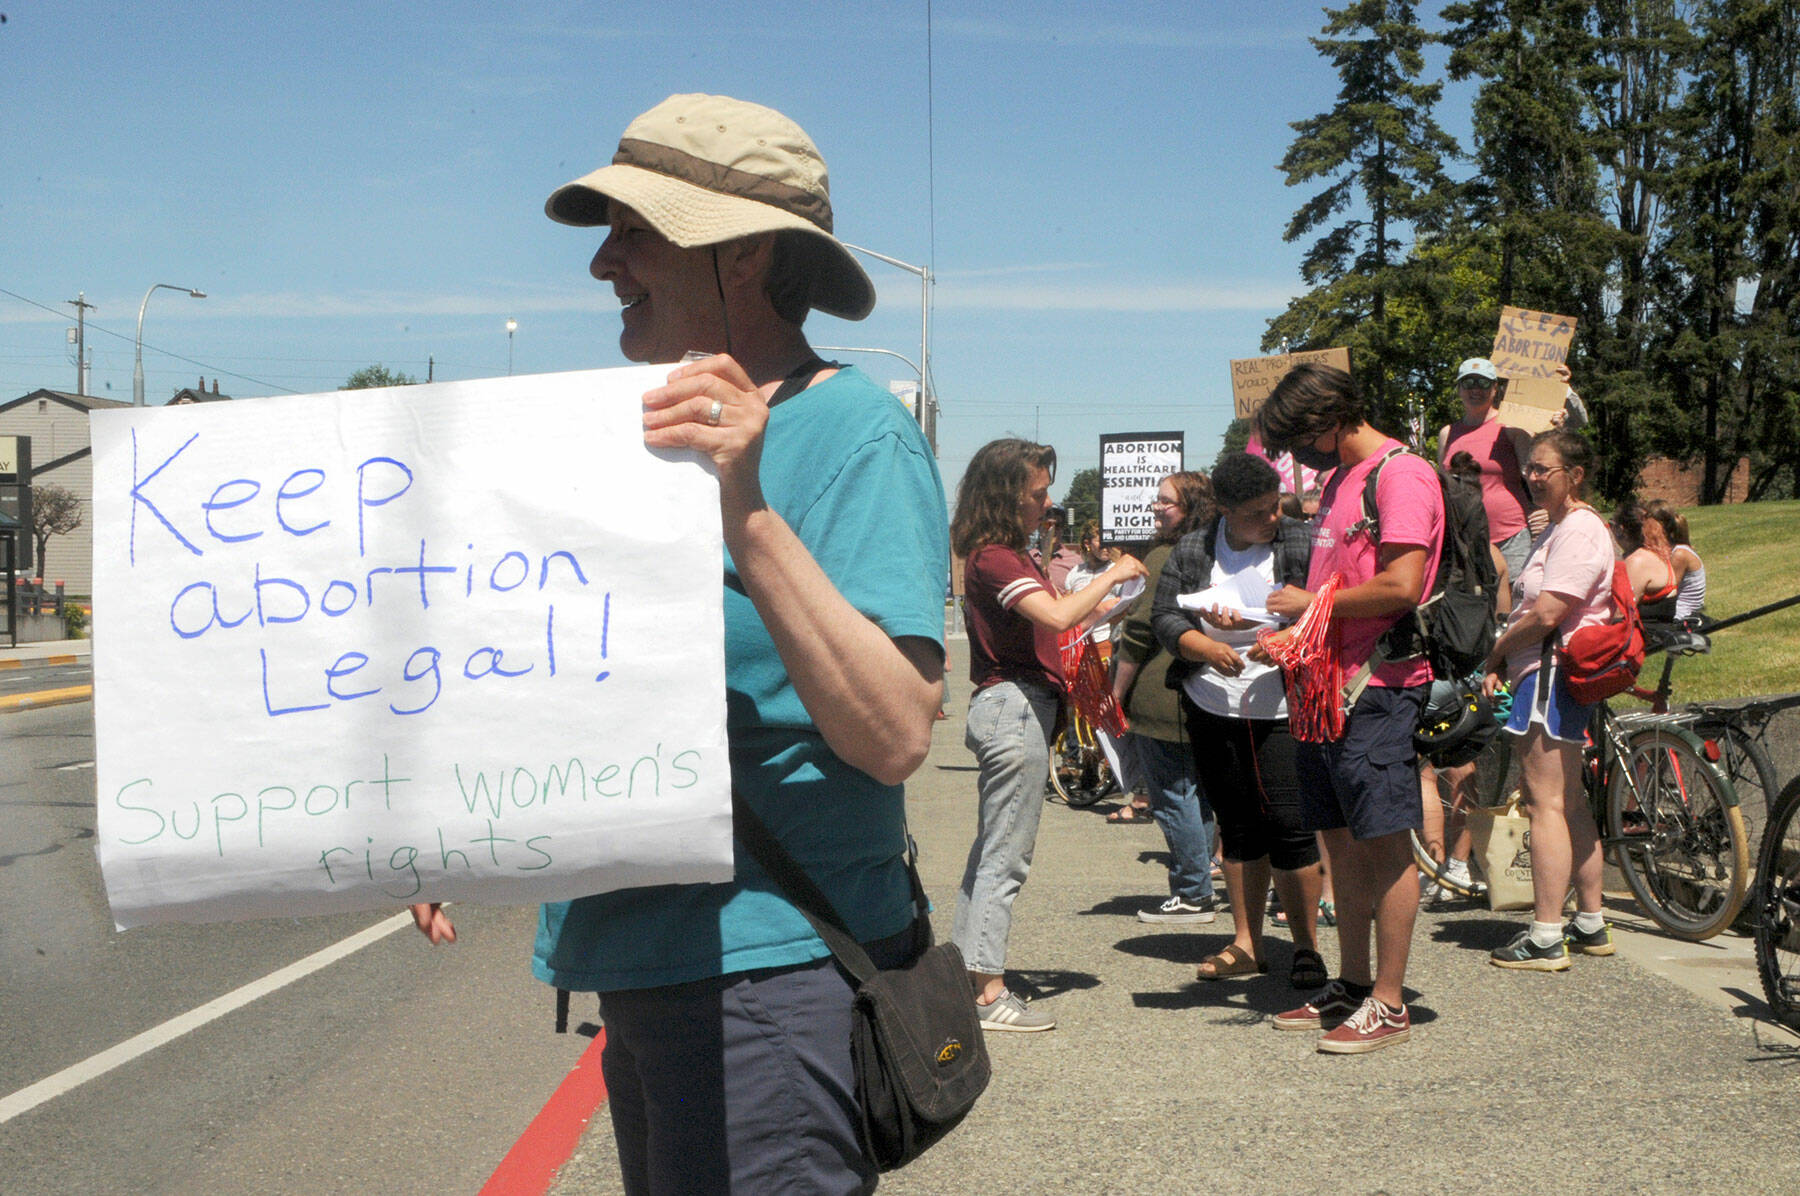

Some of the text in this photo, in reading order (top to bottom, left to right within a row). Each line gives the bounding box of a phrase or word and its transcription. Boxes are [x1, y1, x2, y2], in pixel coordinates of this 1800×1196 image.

[1496, 334, 1568, 363] ABORTION
[1234, 361, 1261, 376] REAL
[1104, 442, 1181, 454] ABORTION
[1137, 456, 1146, 464] IS
[1104, 464, 1177, 474] HEALTHCARE
[1103, 477, 1160, 488] ESSENTI
[131, 427, 415, 567] Keep
[1113, 504, 1154, 513] HUMA
[1114, 517, 1156, 527] RIGH
[171, 539, 590, 640] abortion
[261, 592, 611, 717] Legal!
[116, 753, 412, 856] Support
[319, 820, 553, 898] rights
